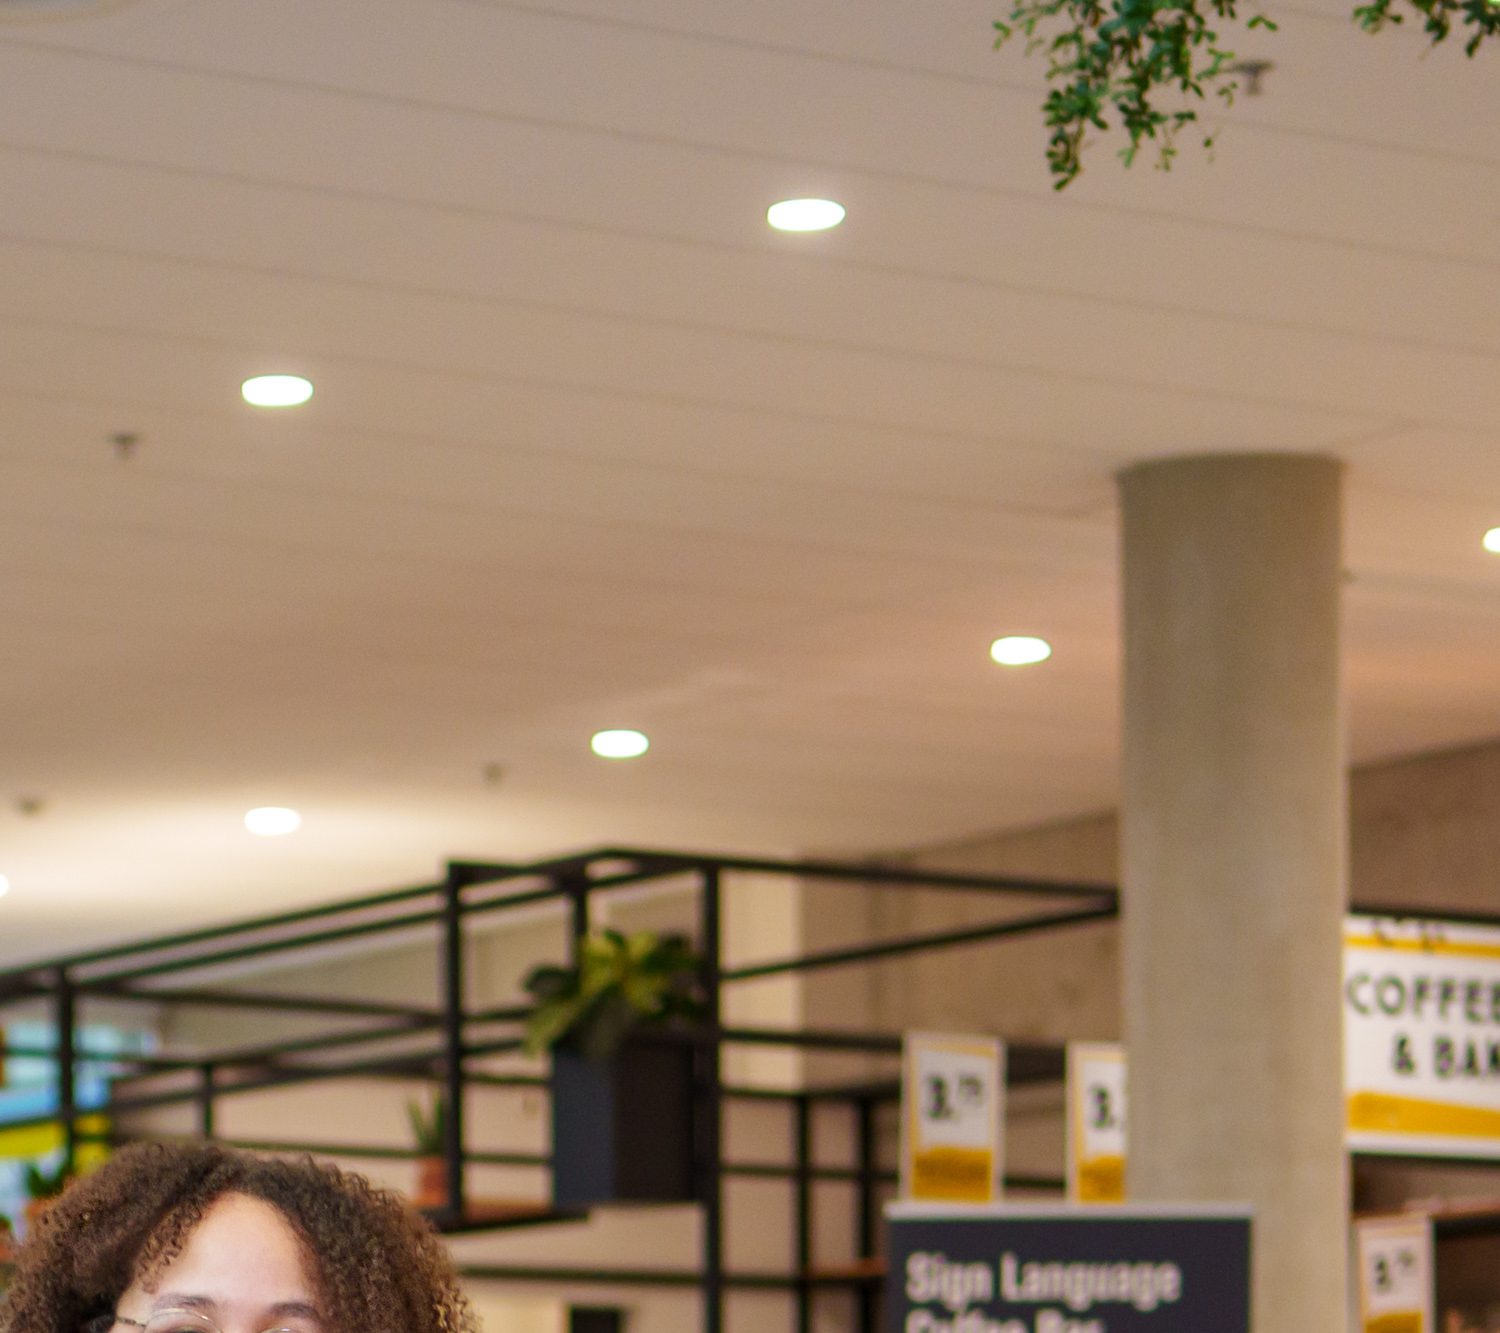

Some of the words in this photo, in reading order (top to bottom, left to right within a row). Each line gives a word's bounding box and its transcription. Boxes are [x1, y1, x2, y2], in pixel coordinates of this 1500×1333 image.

[1391, 1034, 1415, 1075] &
[905, 1252, 994, 1311] Sign
[1001, 1252, 1182, 1312] Language
